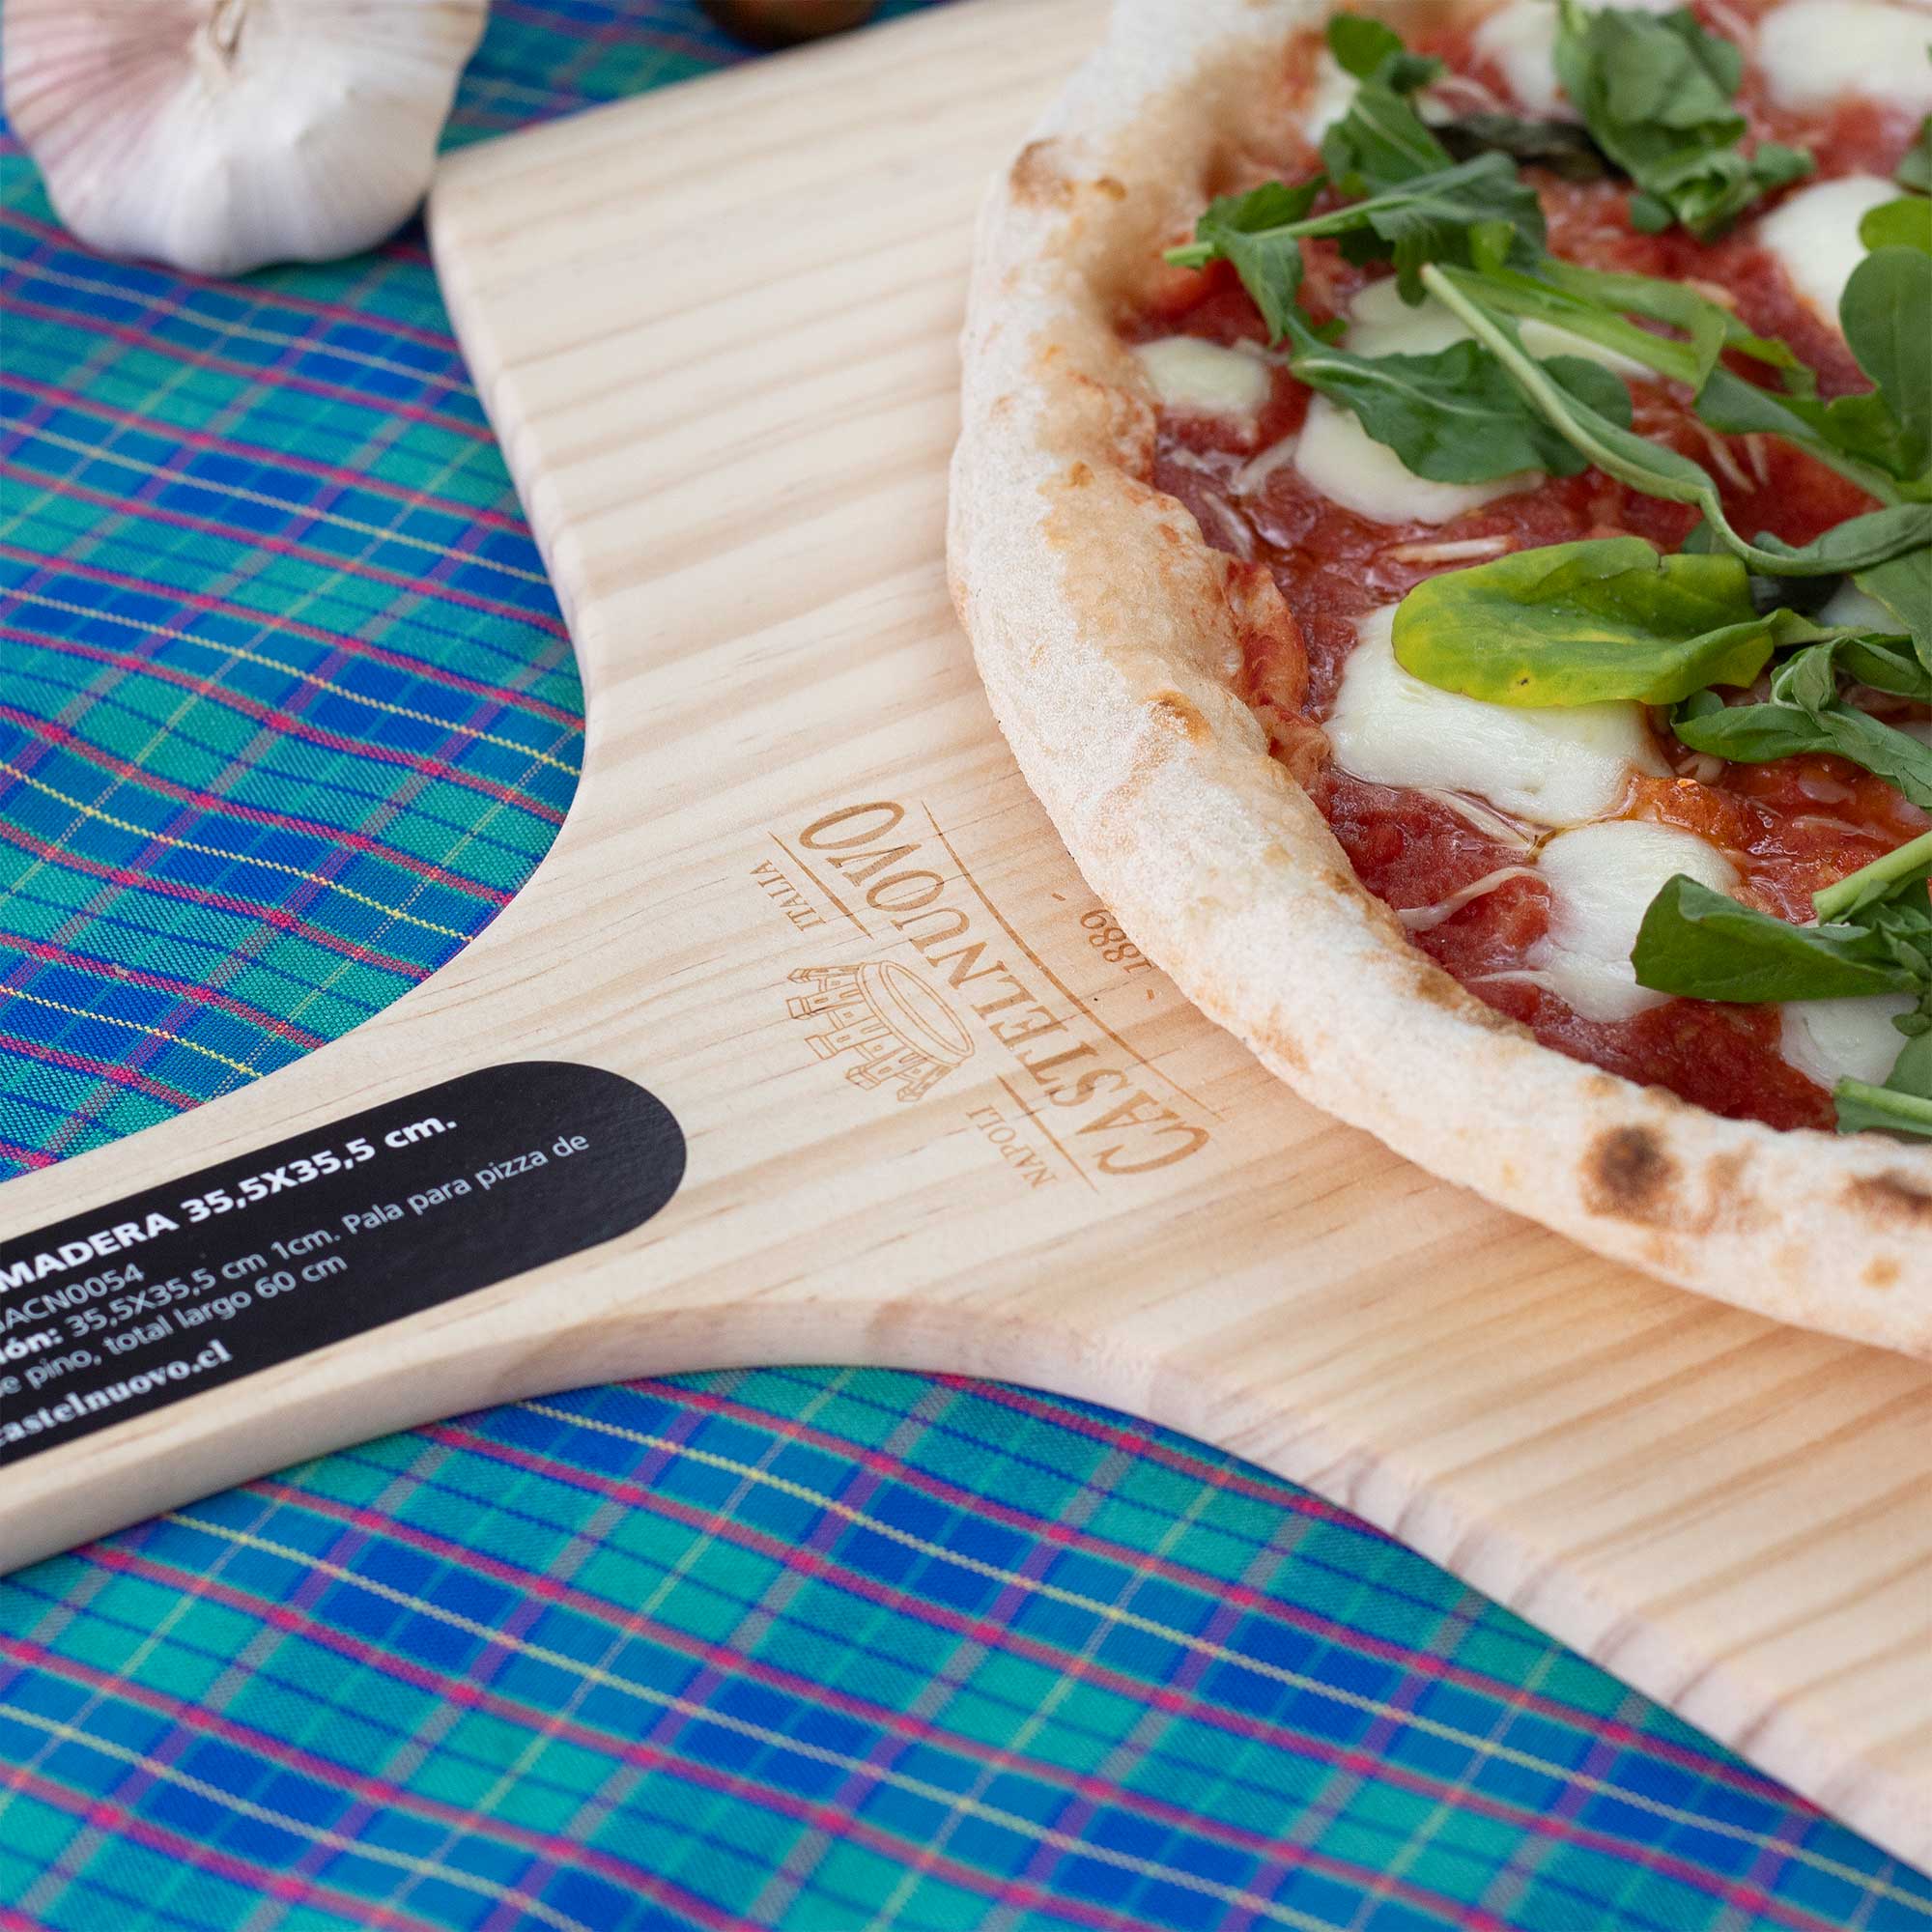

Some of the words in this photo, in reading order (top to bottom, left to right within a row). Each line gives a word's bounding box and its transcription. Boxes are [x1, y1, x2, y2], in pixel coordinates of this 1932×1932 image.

[750, 860, 827, 932] ITALIA
[1079, 909, 1153, 974] 1889
[798, 800, 1211, 1177] CASTELNUOVO
[966, 1104, 1059, 1189] NAPOLI
[0, 1212, 180, 1293] MADERA
[180, 1138, 376, 1223] 35,5X35,5
[384, 1117, 458, 1149] cm.
[64, 1267, 216, 1337] 35,5X35,5
[220, 1251, 268, 1280] cm
[270, 1229, 341, 1261] 1cm.
[342, 1206, 405, 1235] Pala
[407, 1178, 472, 1215] para
[474, 1151, 550, 1190] pizza
[553, 1135, 590, 1159] de
[0, 1263, 145, 1334] ACN0054
[102, 1316, 174, 1355] total
[172, 1291, 252, 1330] largo
[254, 1270, 298, 1299] 60
[300, 1255, 349, 1284] cm
